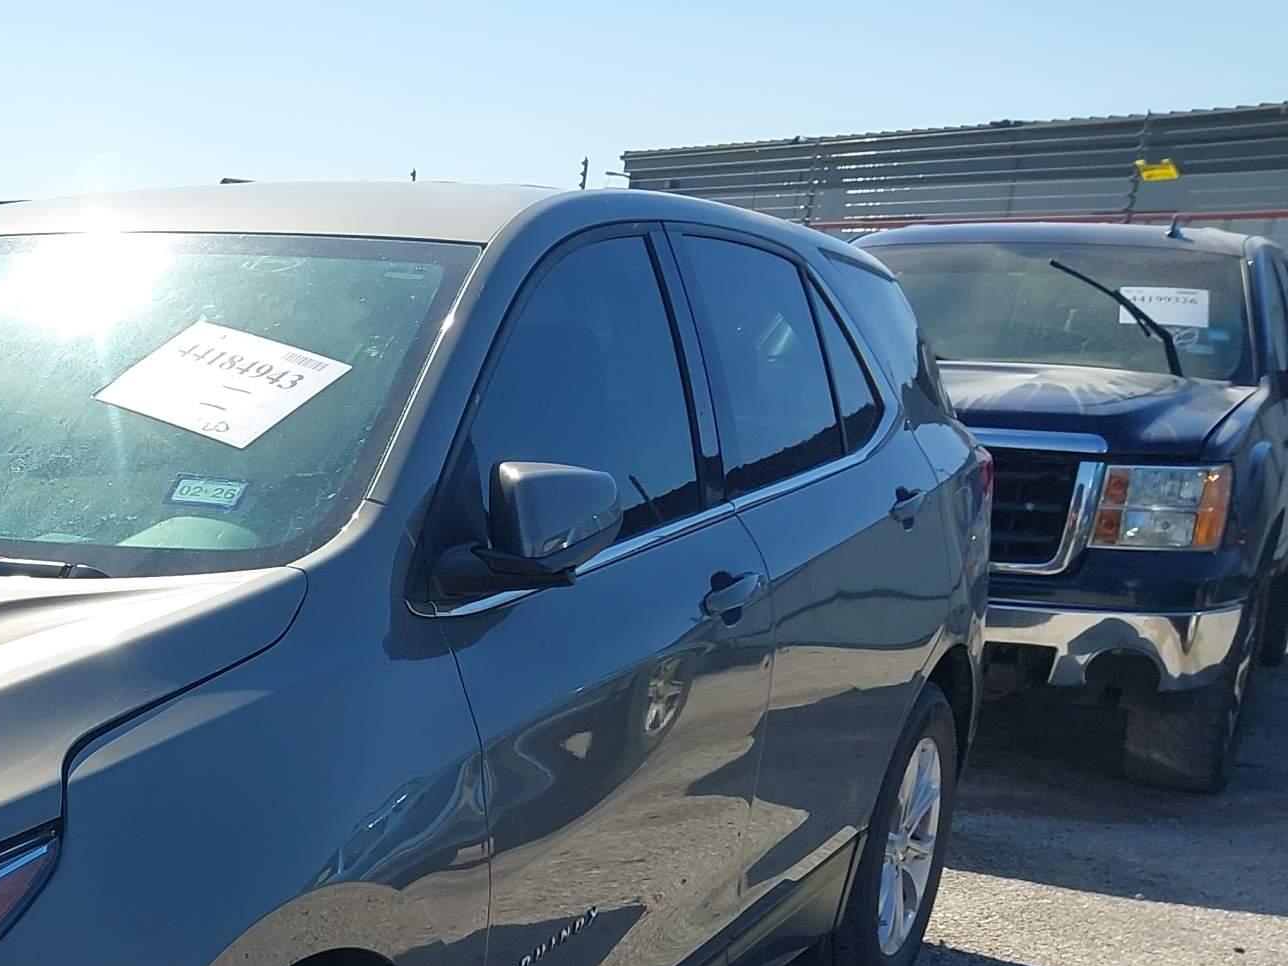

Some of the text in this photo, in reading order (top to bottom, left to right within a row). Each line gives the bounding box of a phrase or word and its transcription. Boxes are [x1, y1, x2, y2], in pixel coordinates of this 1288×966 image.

[178, 344, 304, 390] 44184943
[178, 485, 237, 500] 02 26
